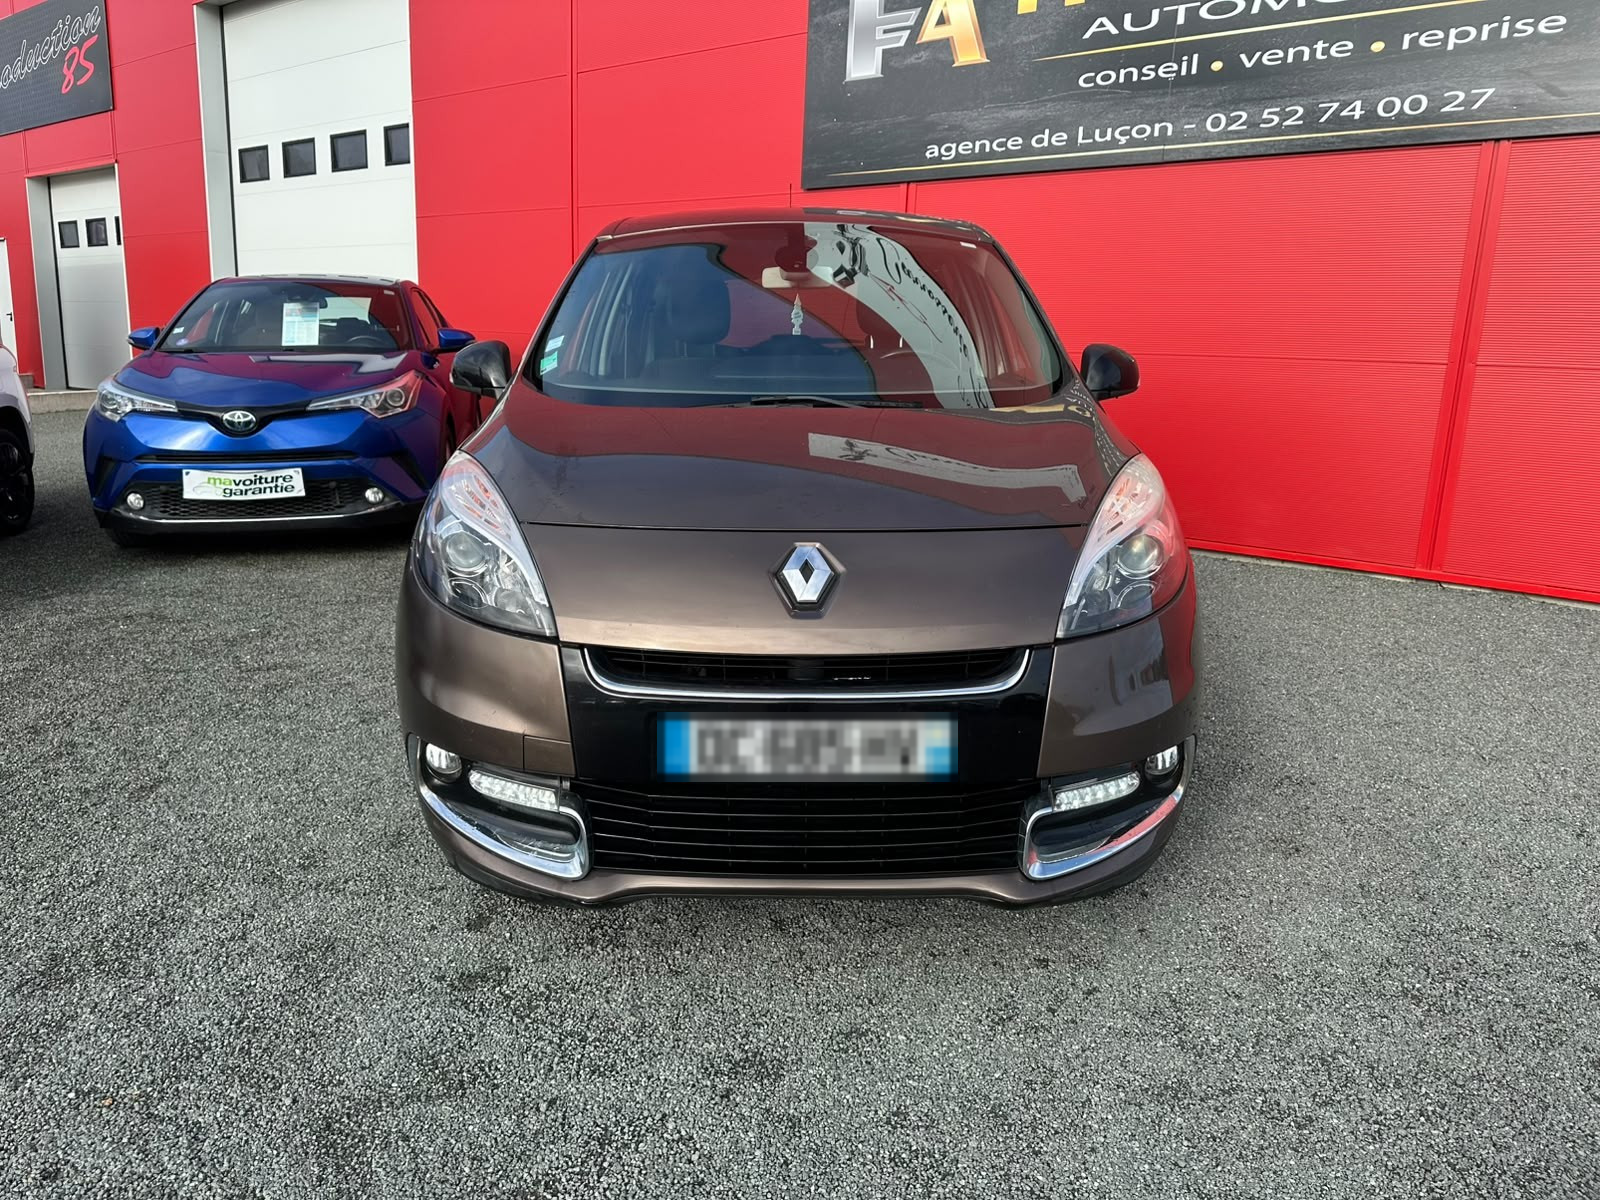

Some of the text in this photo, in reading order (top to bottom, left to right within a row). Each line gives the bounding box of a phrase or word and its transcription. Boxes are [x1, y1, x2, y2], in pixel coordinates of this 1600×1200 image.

[0, 5, 101, 89] oduction
[1078, 14, 1568, 88] conseil vente reprise
[1082, 0, 1347, 40] AUTO
[61, 34, 98, 94] 85
[924, 135, 1024, 160] agence
[1030, 129, 1069, 149] de
[1077, 120, 1174, 145] Luçon
[1205, 111, 1248, 132] 02
[1259, 106, 1305, 128] 52
[1317, 100, 1366, 123] 74
[1376, 94, 1429, 118] 00
[1439, 88, 1497, 113] 27
[222, 483, 295, 498] garantie
